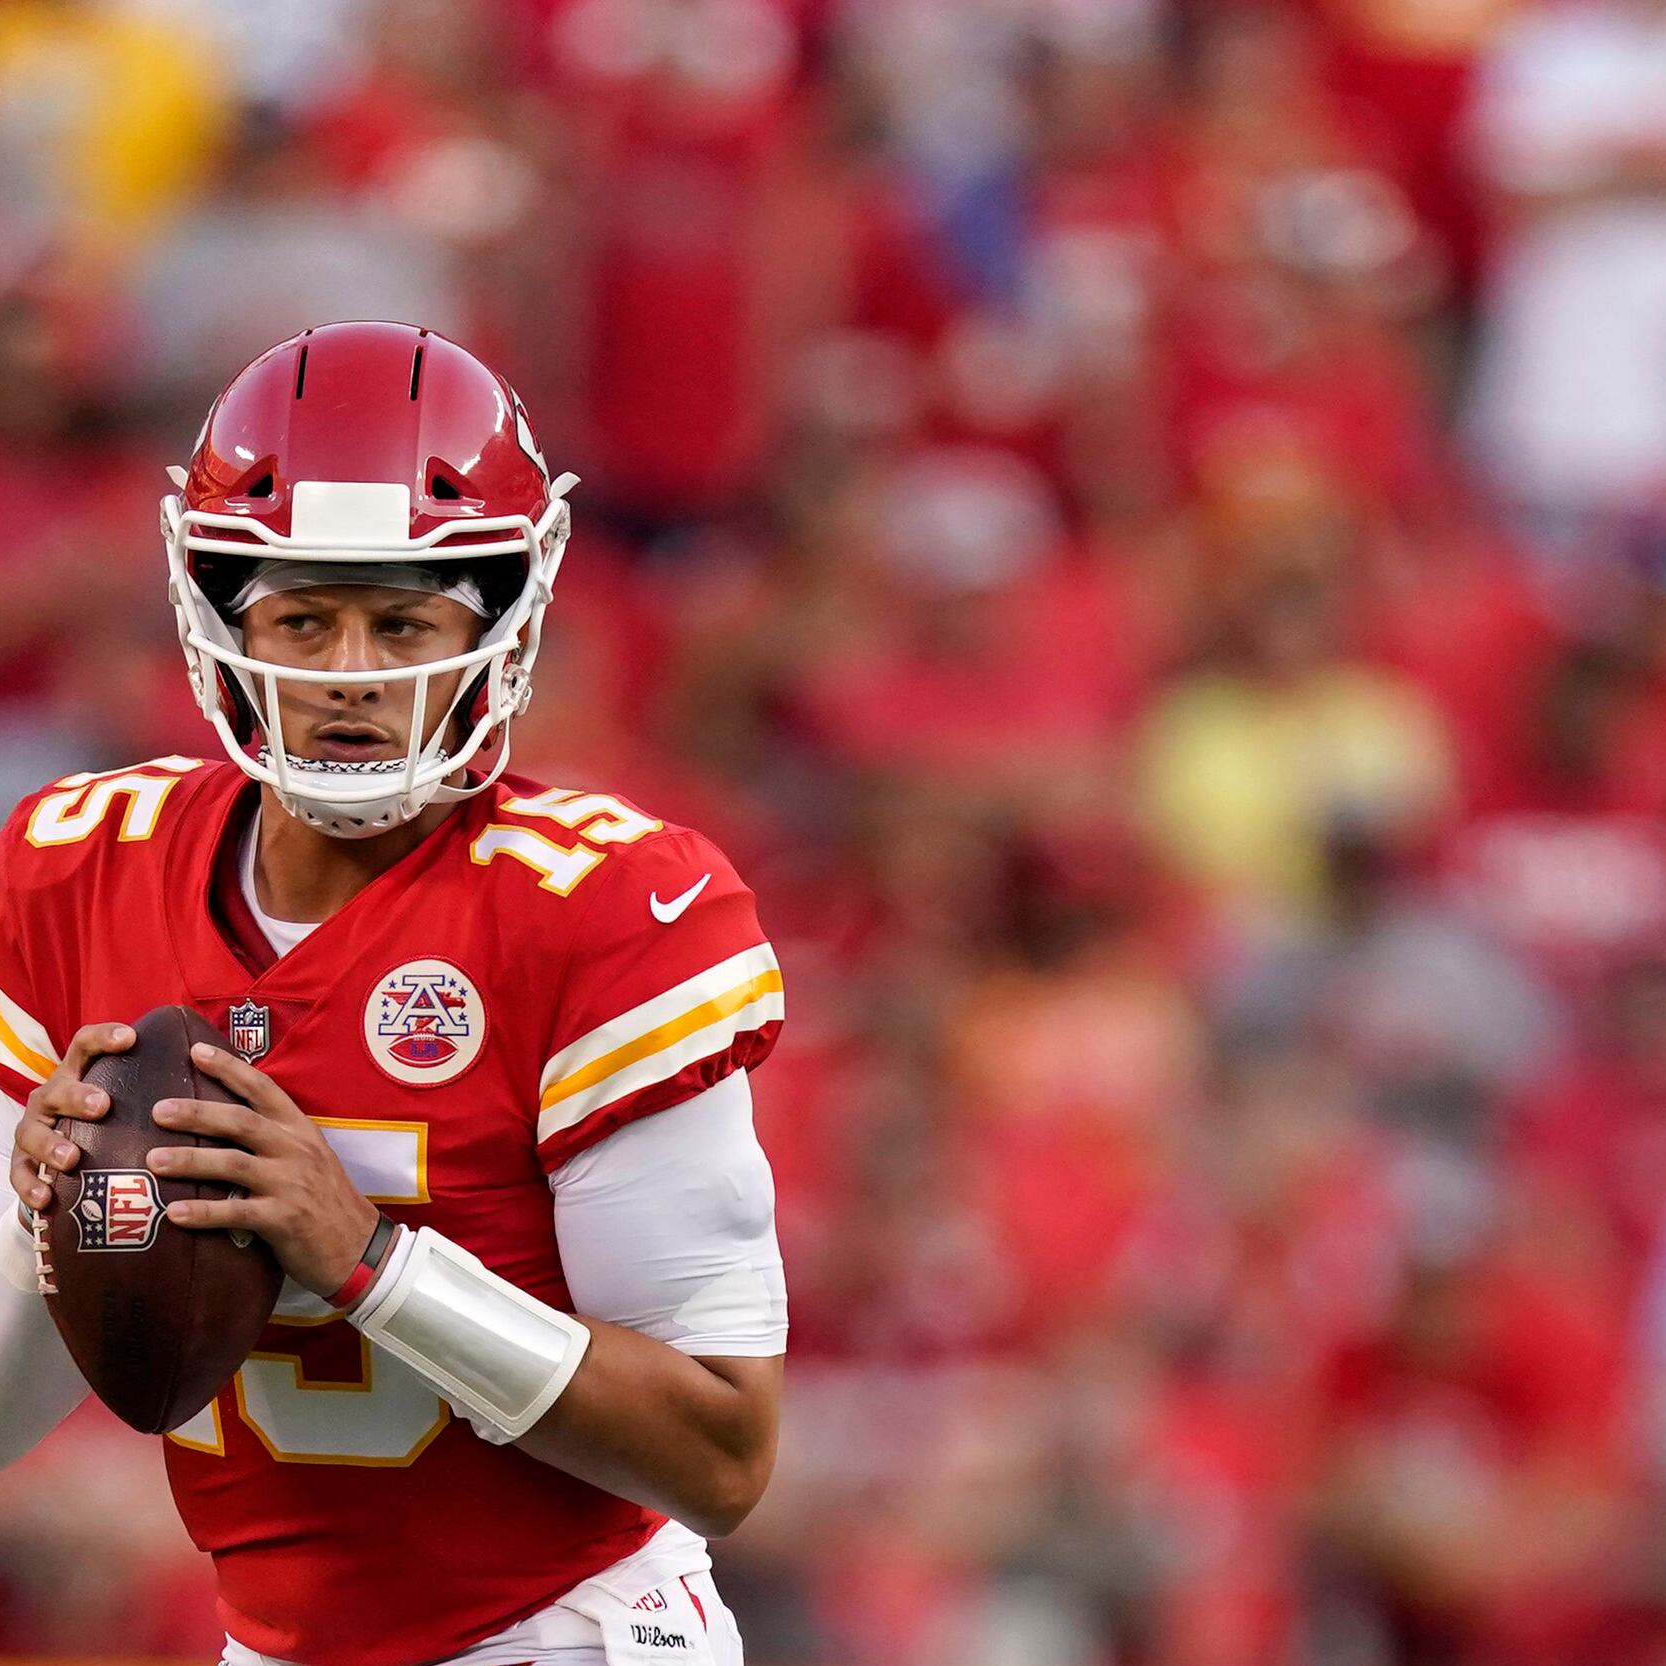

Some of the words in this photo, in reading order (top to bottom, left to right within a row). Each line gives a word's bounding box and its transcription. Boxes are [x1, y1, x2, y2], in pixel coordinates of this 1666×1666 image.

[469, 787, 664, 898] 15
[236, 1028, 263, 1053] NFL
[109, 1178, 153, 1242] NFL
[165, 1115, 452, 1467] 5
[631, 1624, 687, 1649] Wilson
